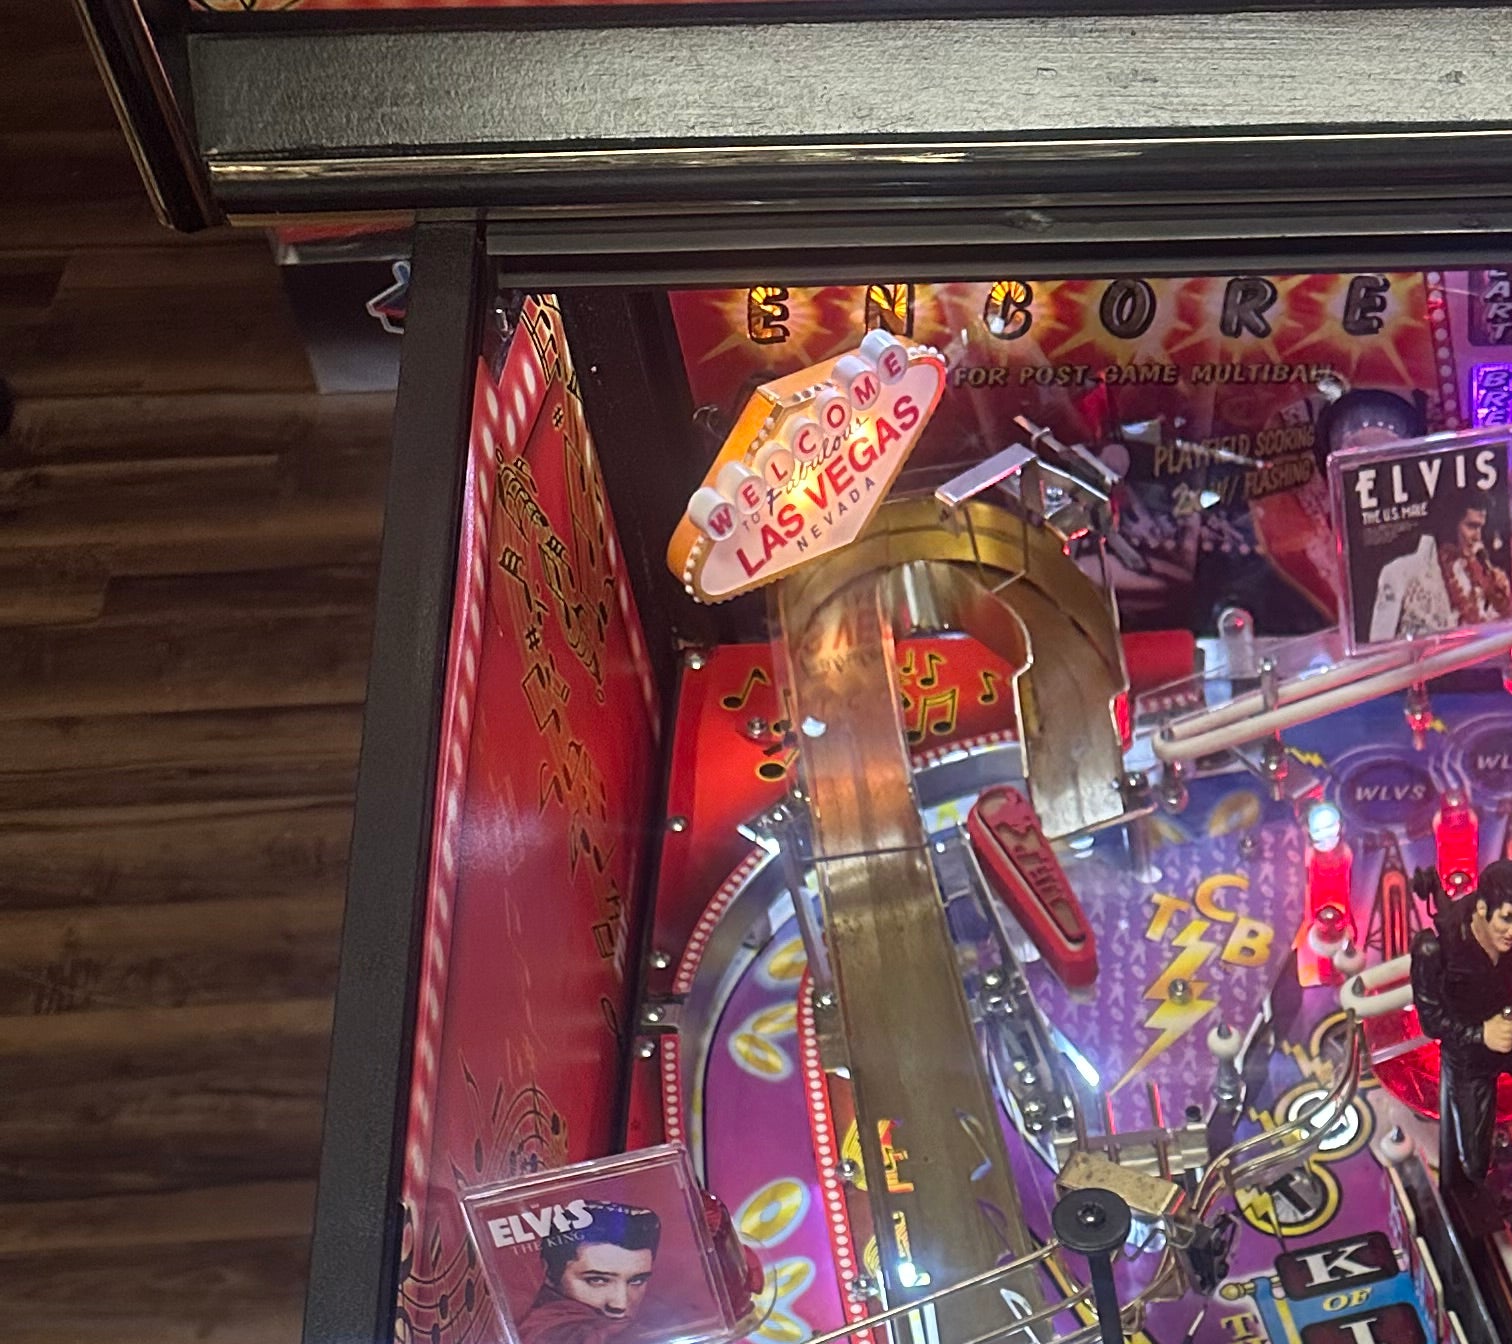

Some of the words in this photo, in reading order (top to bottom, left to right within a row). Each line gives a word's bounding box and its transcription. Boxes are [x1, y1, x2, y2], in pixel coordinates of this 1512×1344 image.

[746, 276, 1392, 343] ENCORE
[953, 368, 1006, 387] FOR
[707, 352, 903, 537] WELCOME
[1255, 424, 1316, 457] SCORING
[736, 502, 805, 578] LAS
[802, 394, 920, 511] VEGAS
[742, 513, 762, 531] TO
[765, 415, 869, 517] Fabulous
[1355, 450, 1498, 512] ELVIS
[796, 476, 876, 553] NEVADA
[1361, 508, 1381, 525] THE
[1355, 784, 1426, 802] WLVS
[487, 1199, 595, 1250] ELVIS
[511, 1237, 543, 1257] THE
[545, 1230, 586, 1249] KING
[1321, 1286, 1372, 1312] OF
